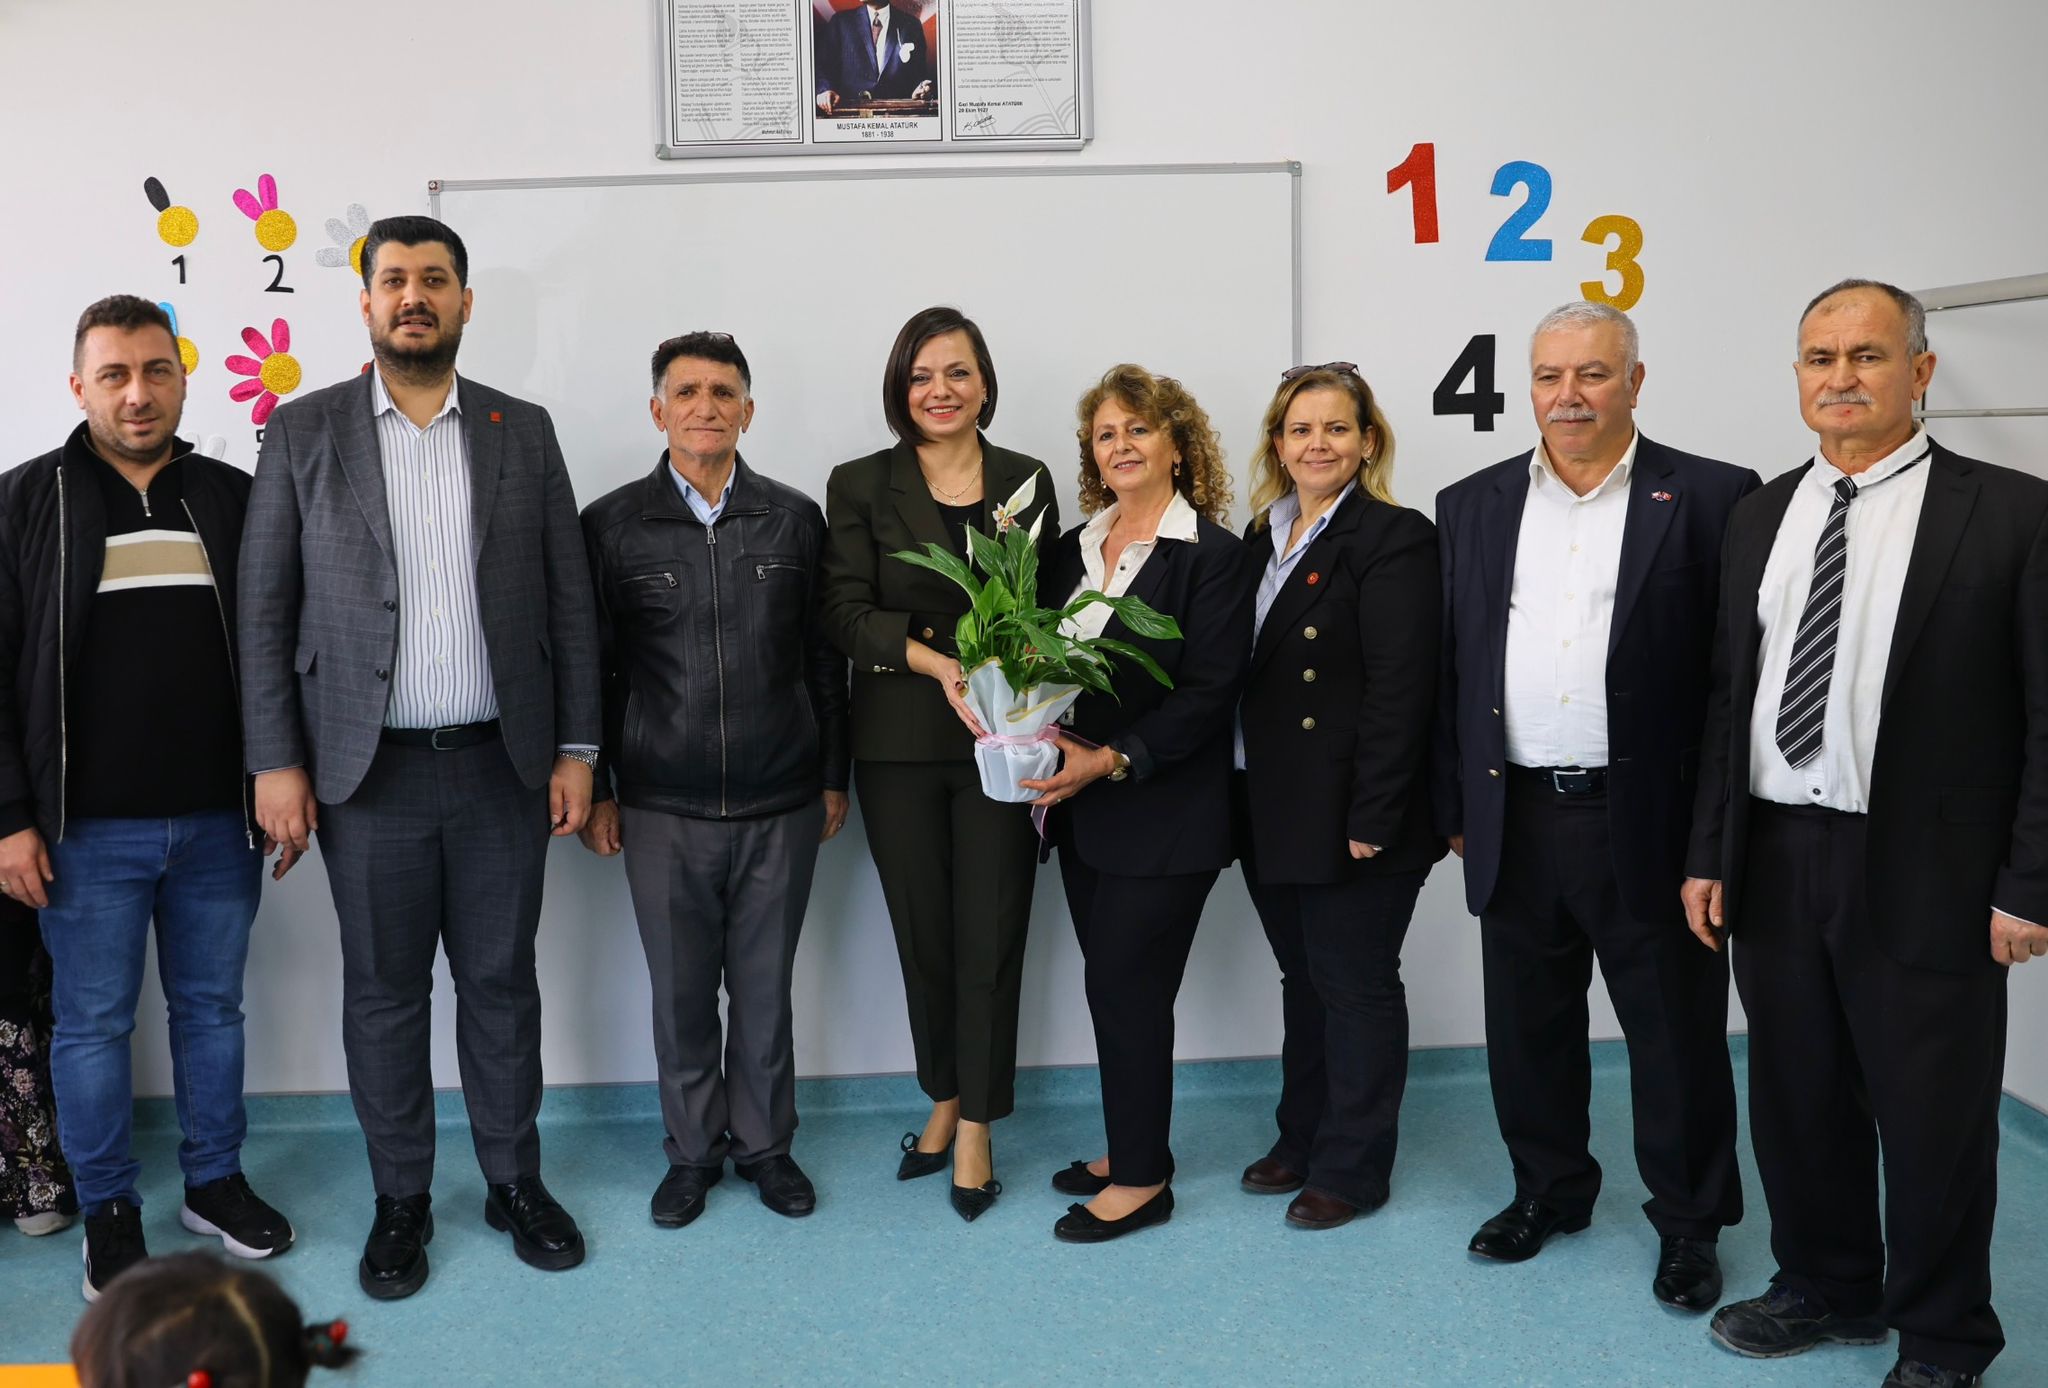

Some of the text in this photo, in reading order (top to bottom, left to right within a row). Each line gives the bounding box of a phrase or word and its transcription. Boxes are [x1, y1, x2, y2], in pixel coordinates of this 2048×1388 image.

[1387, 142, 1439, 244] 1
[1485, 160, 1553, 262] 2
[171, 254, 186, 284] 1
[262, 254, 294, 293] 2
[1580, 214, 1645, 312] 3
[1433, 334, 1505, 432] 4
